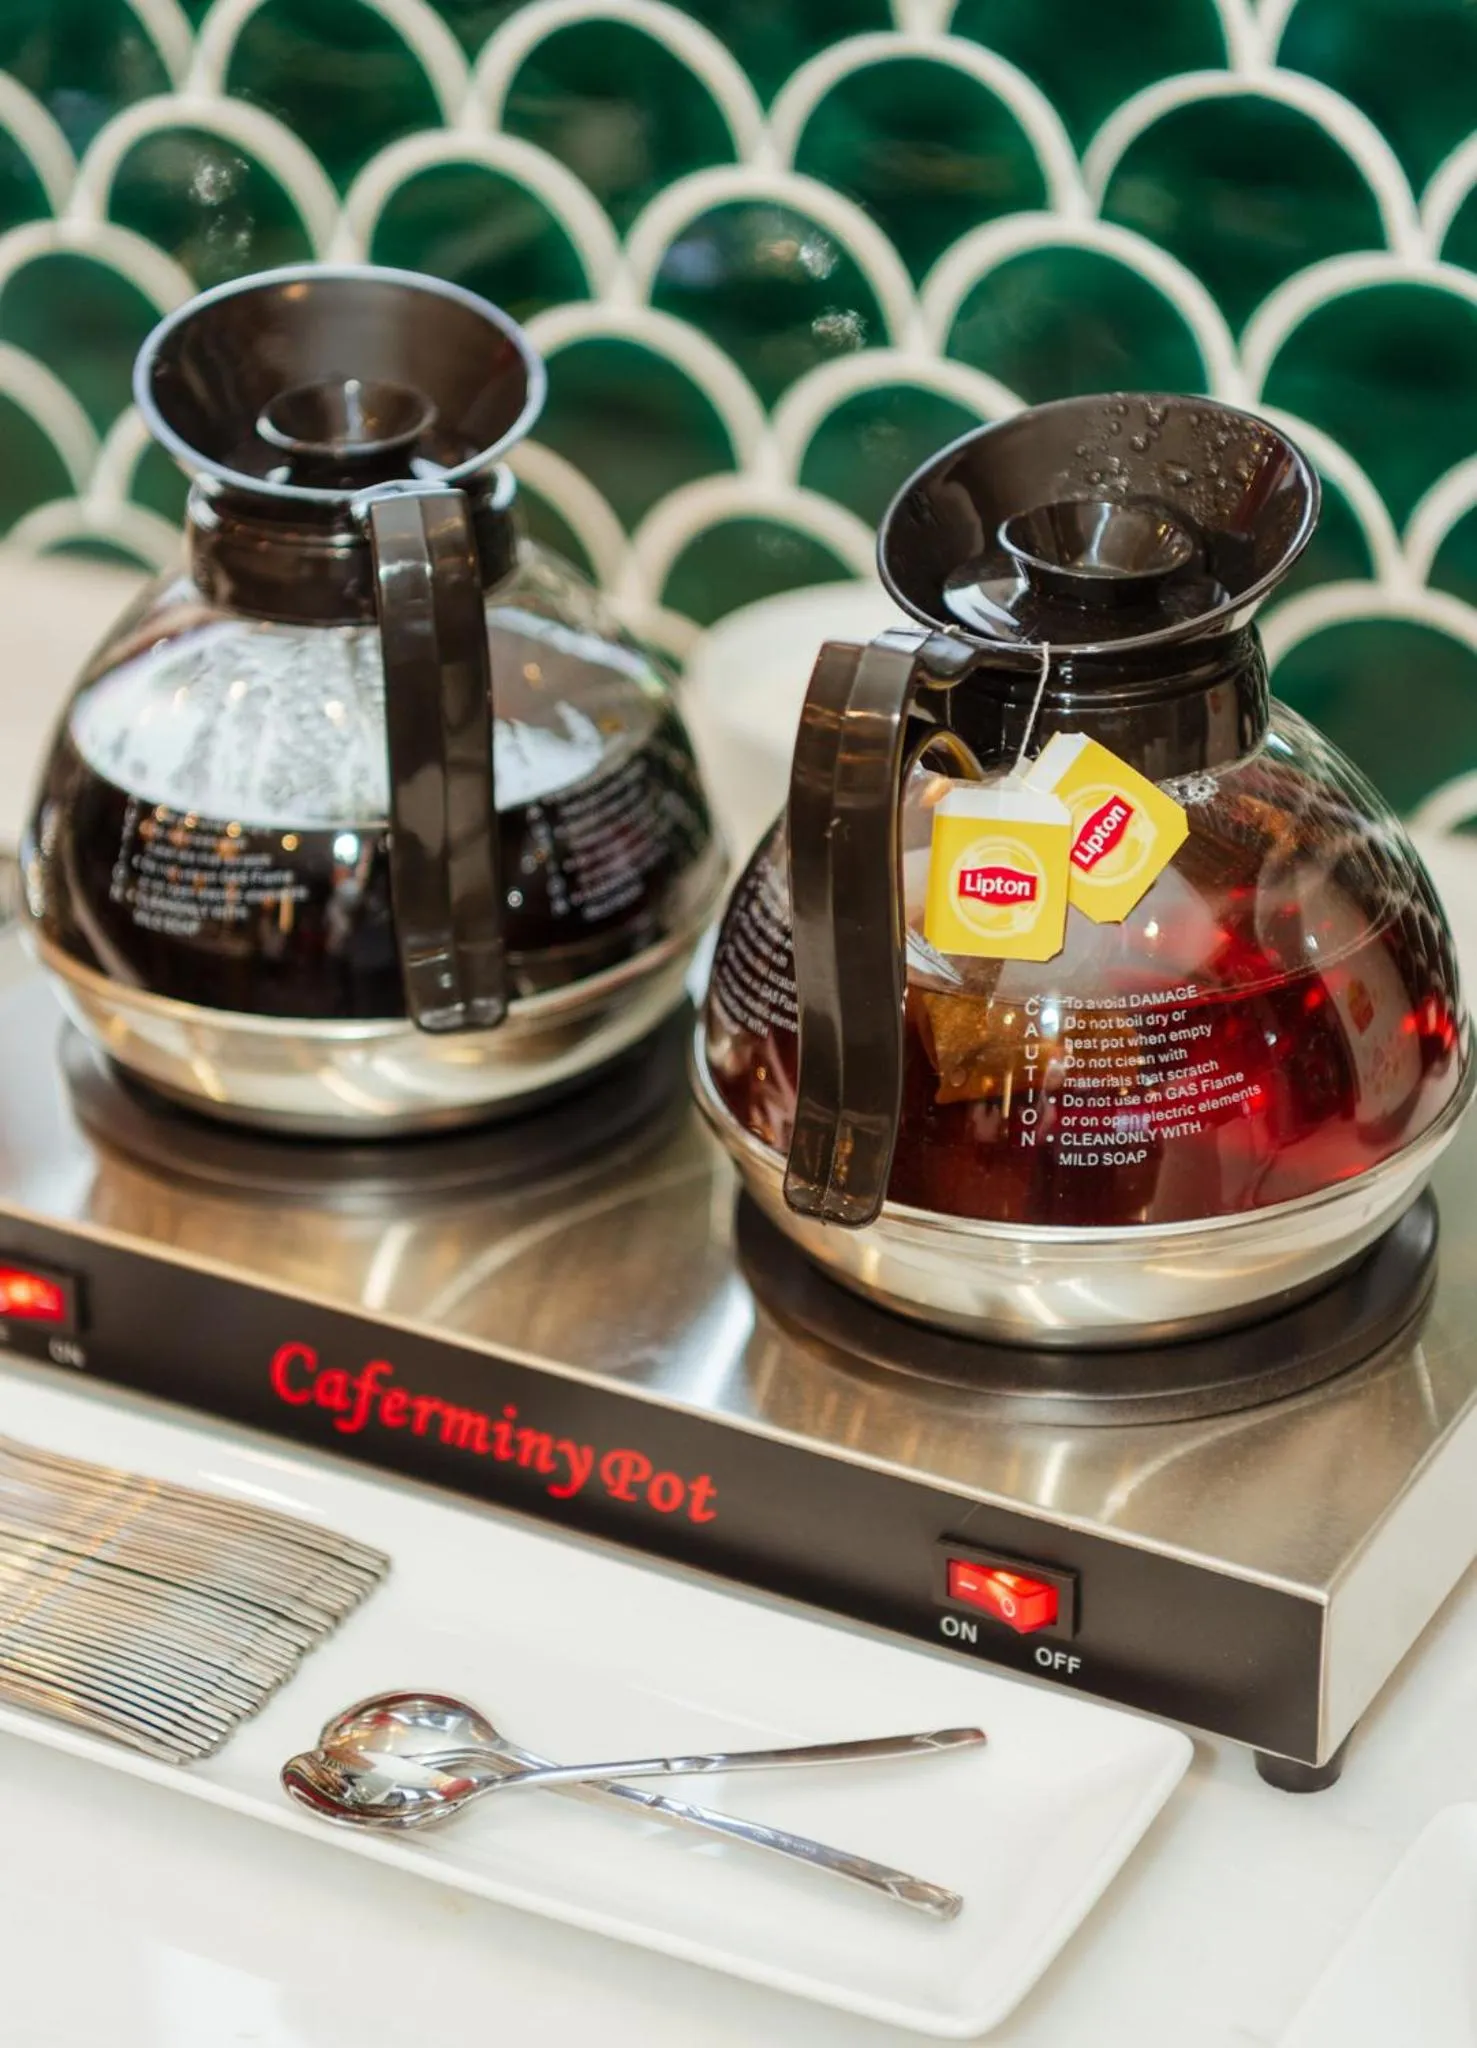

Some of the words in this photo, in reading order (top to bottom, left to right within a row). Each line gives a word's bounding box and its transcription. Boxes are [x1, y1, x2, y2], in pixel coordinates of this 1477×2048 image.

[1074, 805, 1126, 864] Lipton
[965, 874, 1030, 896] Lipton
[1067, 996, 1083, 1009] To
[1087, 996, 1127, 1009] avoid
[1130, 985, 1199, 1007] DAMAGE
[1064, 1016, 1085, 1030] Do
[1090, 1015, 1113, 1029] not
[1116, 1011, 1143, 1028] boil
[1146, 1010, 1168, 1029] dry
[1172, 1009, 1187, 1022] or
[1101, 1033, 1124, 1052] pot
[1128, 1029, 1167, 1047] when
[1170, 1023, 1212, 1043] empty
[1064, 1055, 1085, 1068] Do
[1089, 1054, 1113, 1068] not
[1116, 1052, 1155, 1067] clean
[1158, 1048, 1188, 1064] with
[1064, 1074, 1130, 1088] materials
[1137, 1070, 1164, 1086] that
[1166, 1060, 1219, 1082] scratch
[1063, 1094, 1083, 1108] Do
[1087, 1092, 1111, 1107] not
[1114, 1091, 1140, 1106] use
[1144, 1090, 1162, 1103] on
[1165, 1079, 1198, 1101] GAS
[1202, 1071, 1245, 1093] Flame
[1061, 1113, 1077, 1126] or
[1081, 1113, 1098, 1127] on
[1103, 1111, 1141, 1132] open
[1143, 1102, 1195, 1125] electric
[1199, 1084, 1261, 1113] elements
[1161, 1121, 1202, 1140] WITH
[1060, 1152, 1099, 1166] MILD
[1103, 1149, 1147, 1166] SOAP
[270, 1341, 718, 1524] CaferminyPot
[940, 1616, 978, 1643] ON
[1035, 1647, 1081, 1674] OFF
